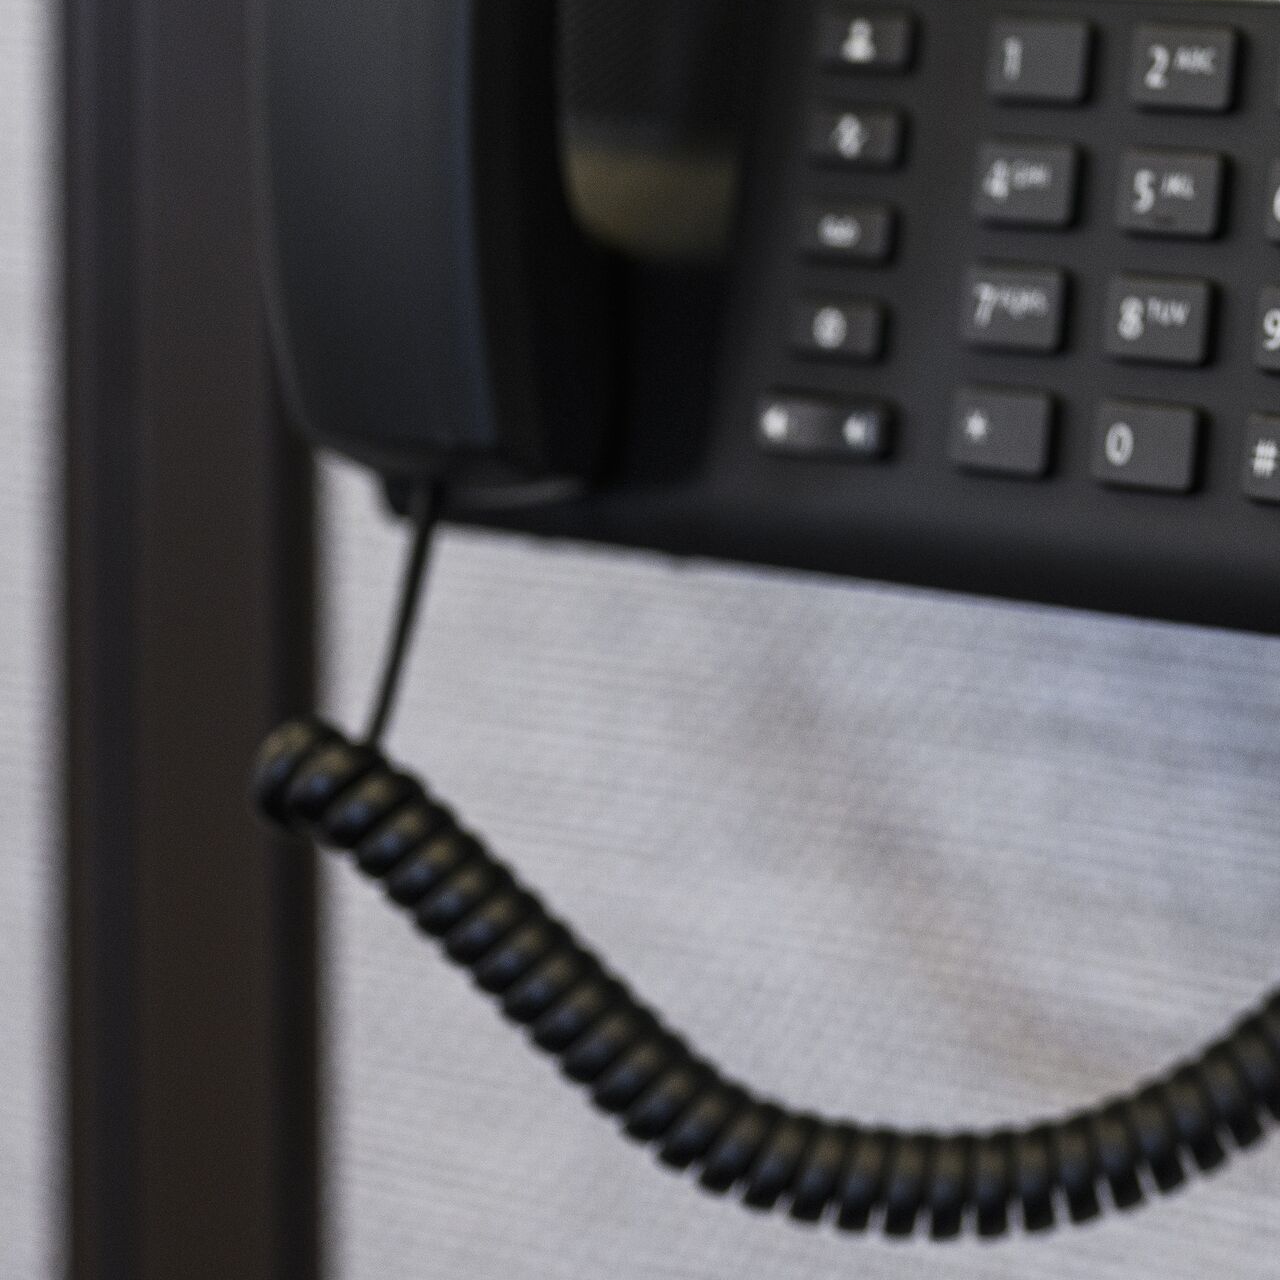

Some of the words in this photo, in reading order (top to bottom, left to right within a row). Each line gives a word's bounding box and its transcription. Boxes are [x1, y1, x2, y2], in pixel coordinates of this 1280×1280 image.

[1003, 36, 1023, 80] 1
[1144, 45, 1170, 89] 2
[1133, 169, 1156, 213] 5
[974, 282, 997, 326] 7
[1117, 296, 1144, 341] 8
[1105, 422, 1134, 467] 0
